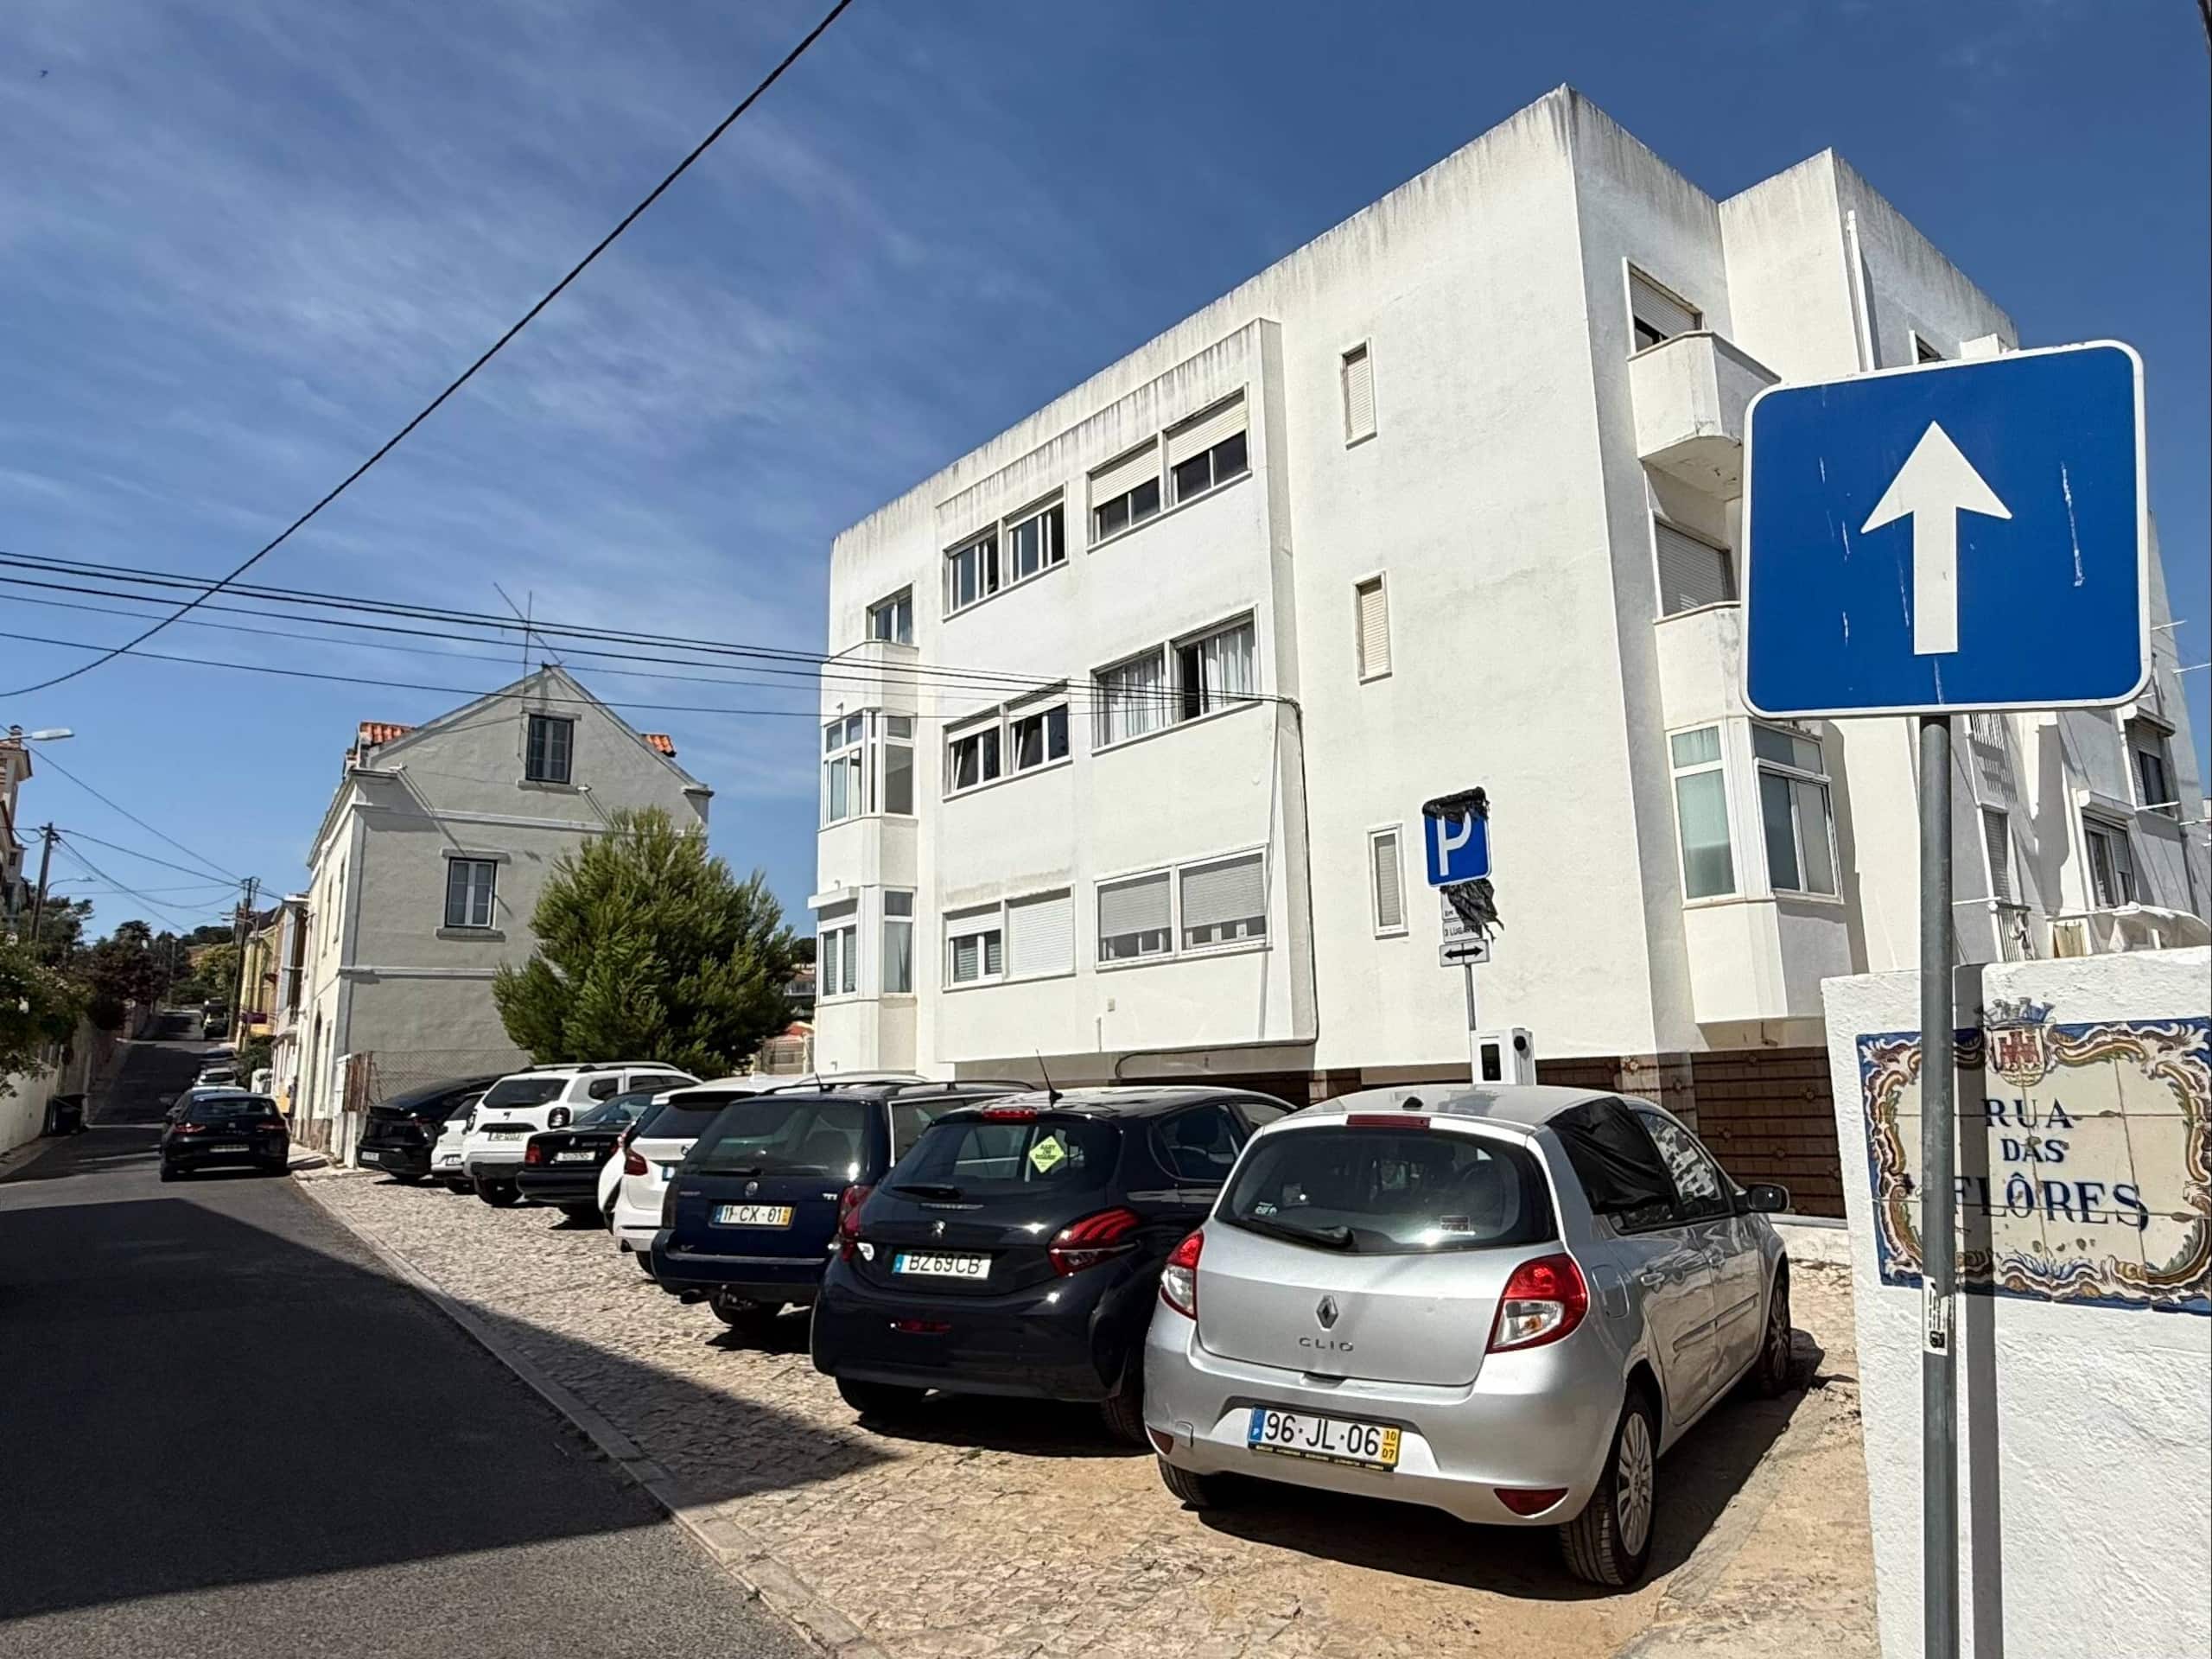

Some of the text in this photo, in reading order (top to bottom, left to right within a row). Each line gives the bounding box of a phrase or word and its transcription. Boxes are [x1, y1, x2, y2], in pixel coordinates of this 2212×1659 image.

[1437, 810, 1472, 876] P
[1980, 1097, 2074, 1128] RUA
[2001, 1138, 2067, 1163] DAS
[1299, 1337, 1354, 1351] CLIO
[1384, 1430, 1396, 1441] 10
[1382, 1448, 1395, 1459] 07
